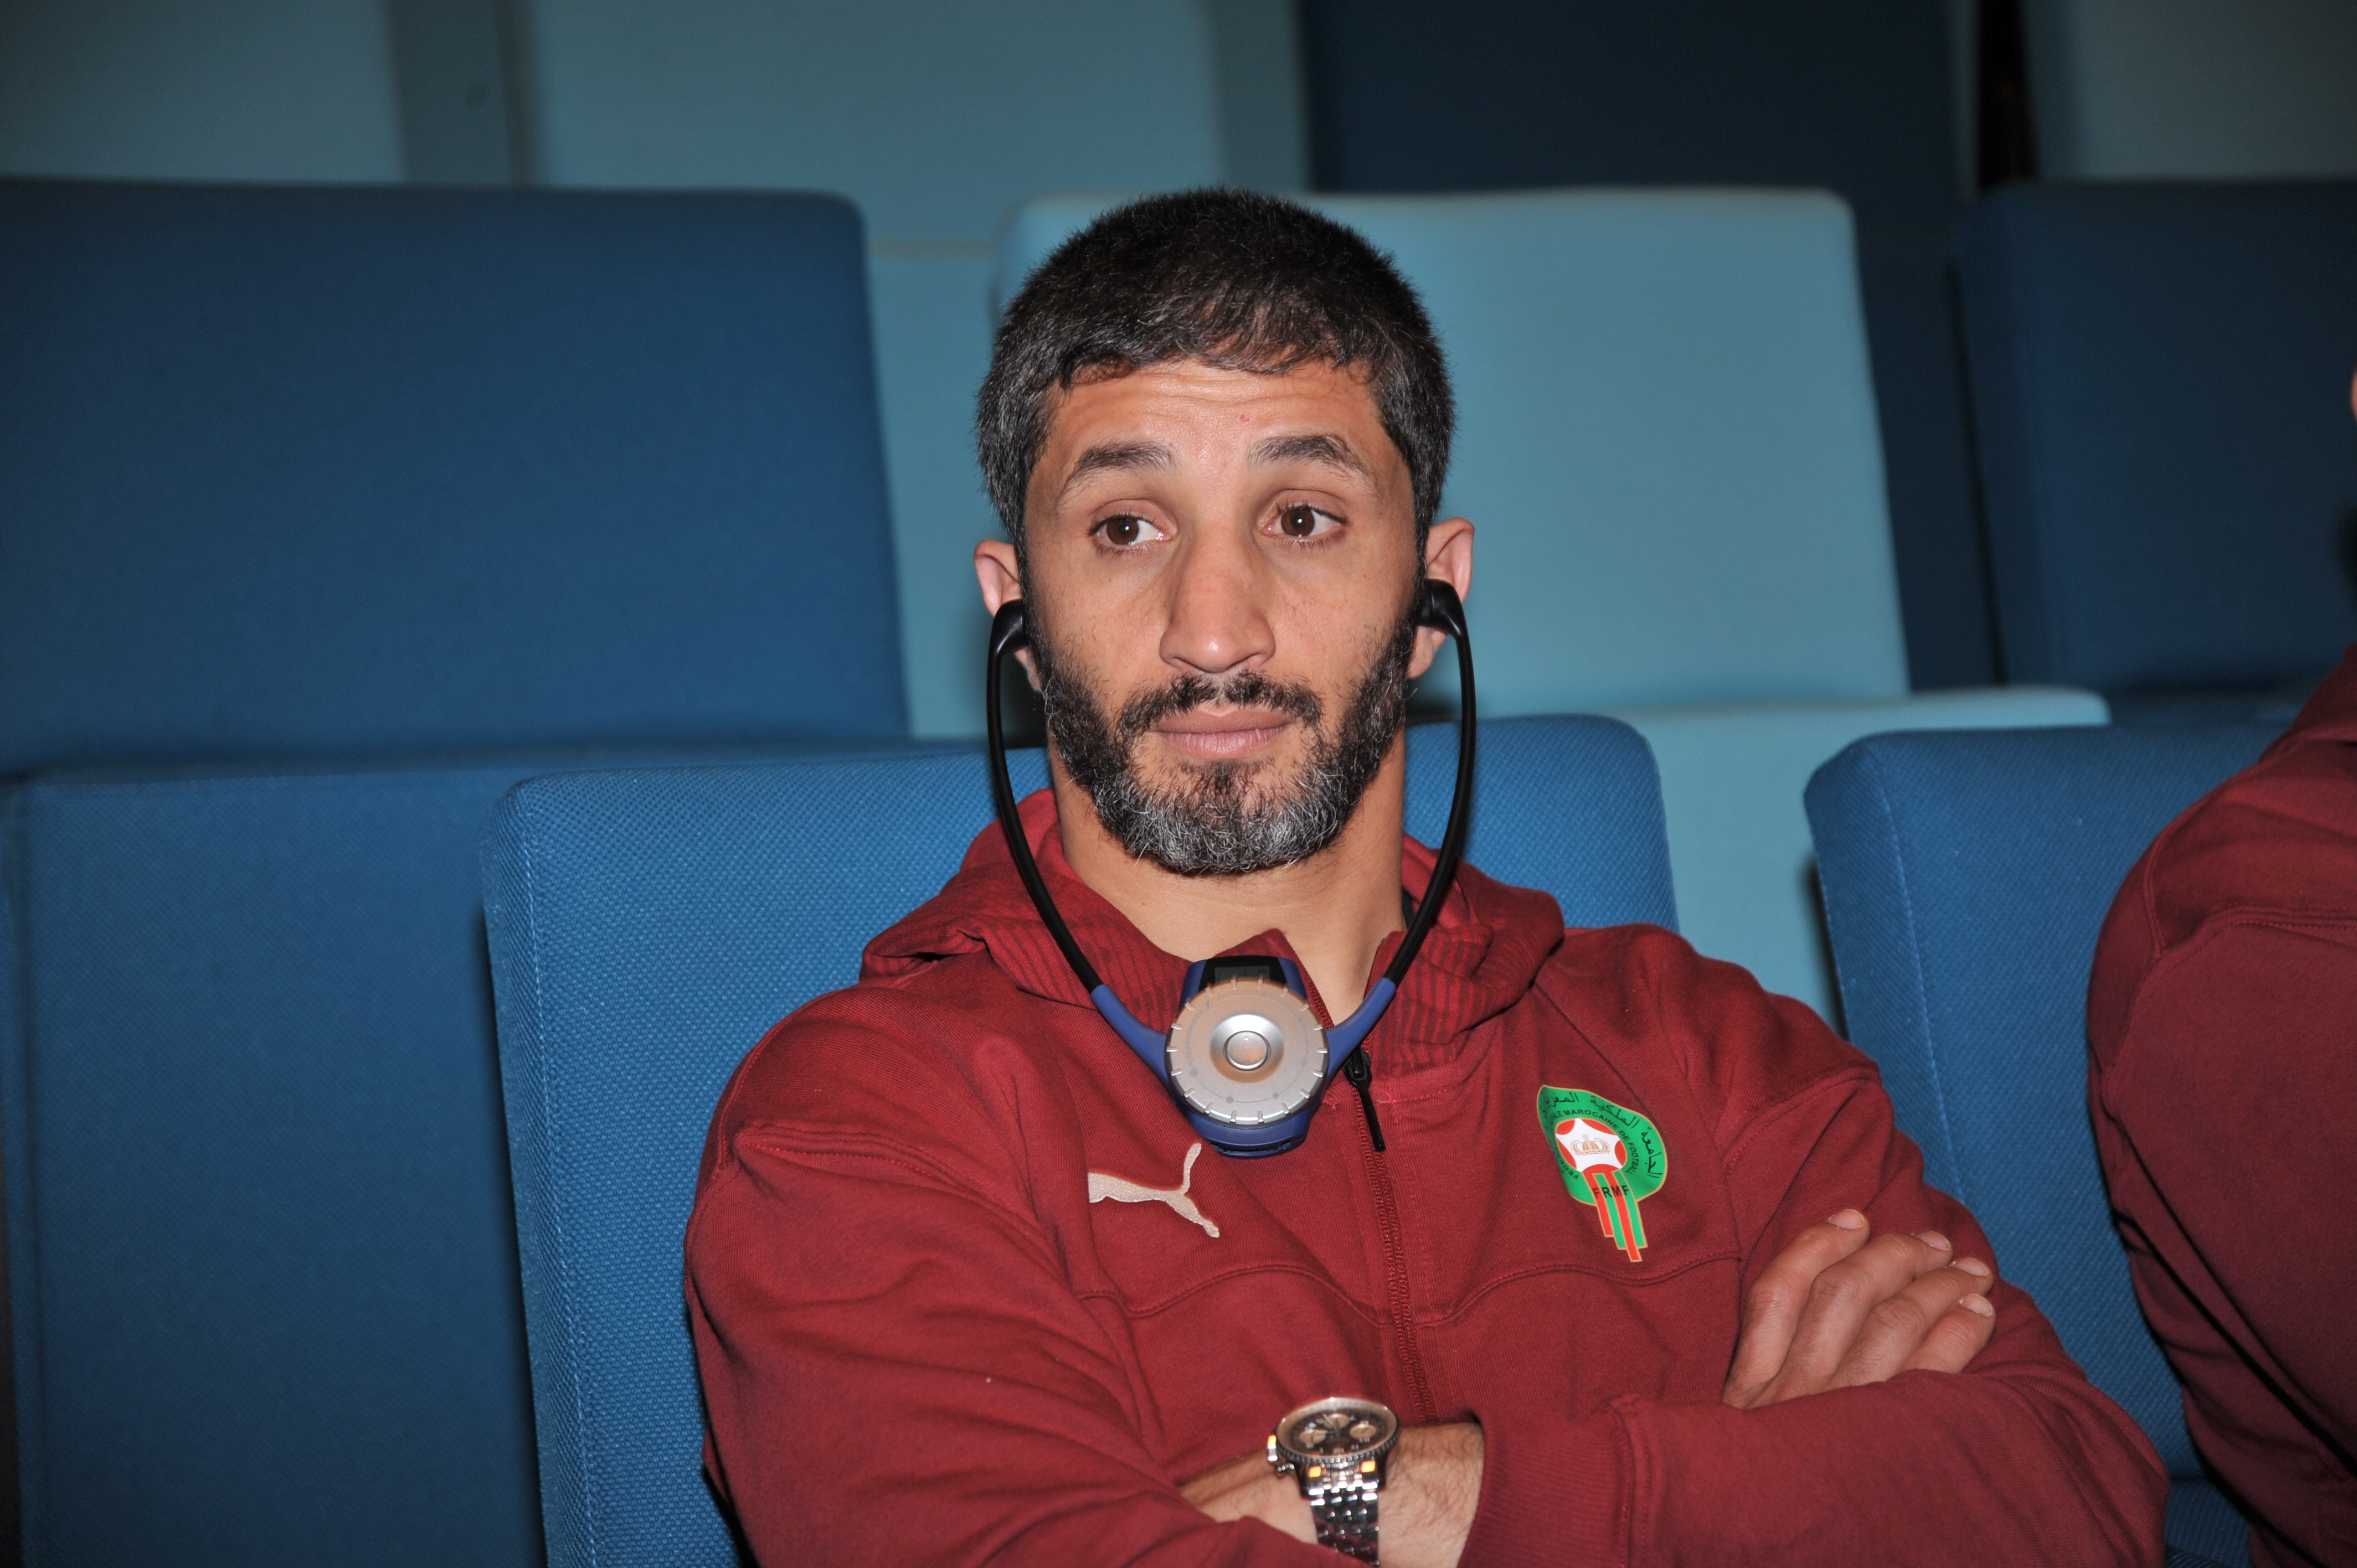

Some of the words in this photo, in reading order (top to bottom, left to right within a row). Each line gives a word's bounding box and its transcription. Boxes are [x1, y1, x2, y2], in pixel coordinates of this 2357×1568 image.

[1590, 1095, 1640, 1128] الملكية
[1563, 1109, 1619, 1130] MAROCAINE
[1618, 1131, 1630, 1141] DE
[1625, 1142, 1639, 1175] FOOTBALL
[1641, 1127, 1663, 1179] الجامعة
[1592, 1185, 1629, 1199] FRMF
